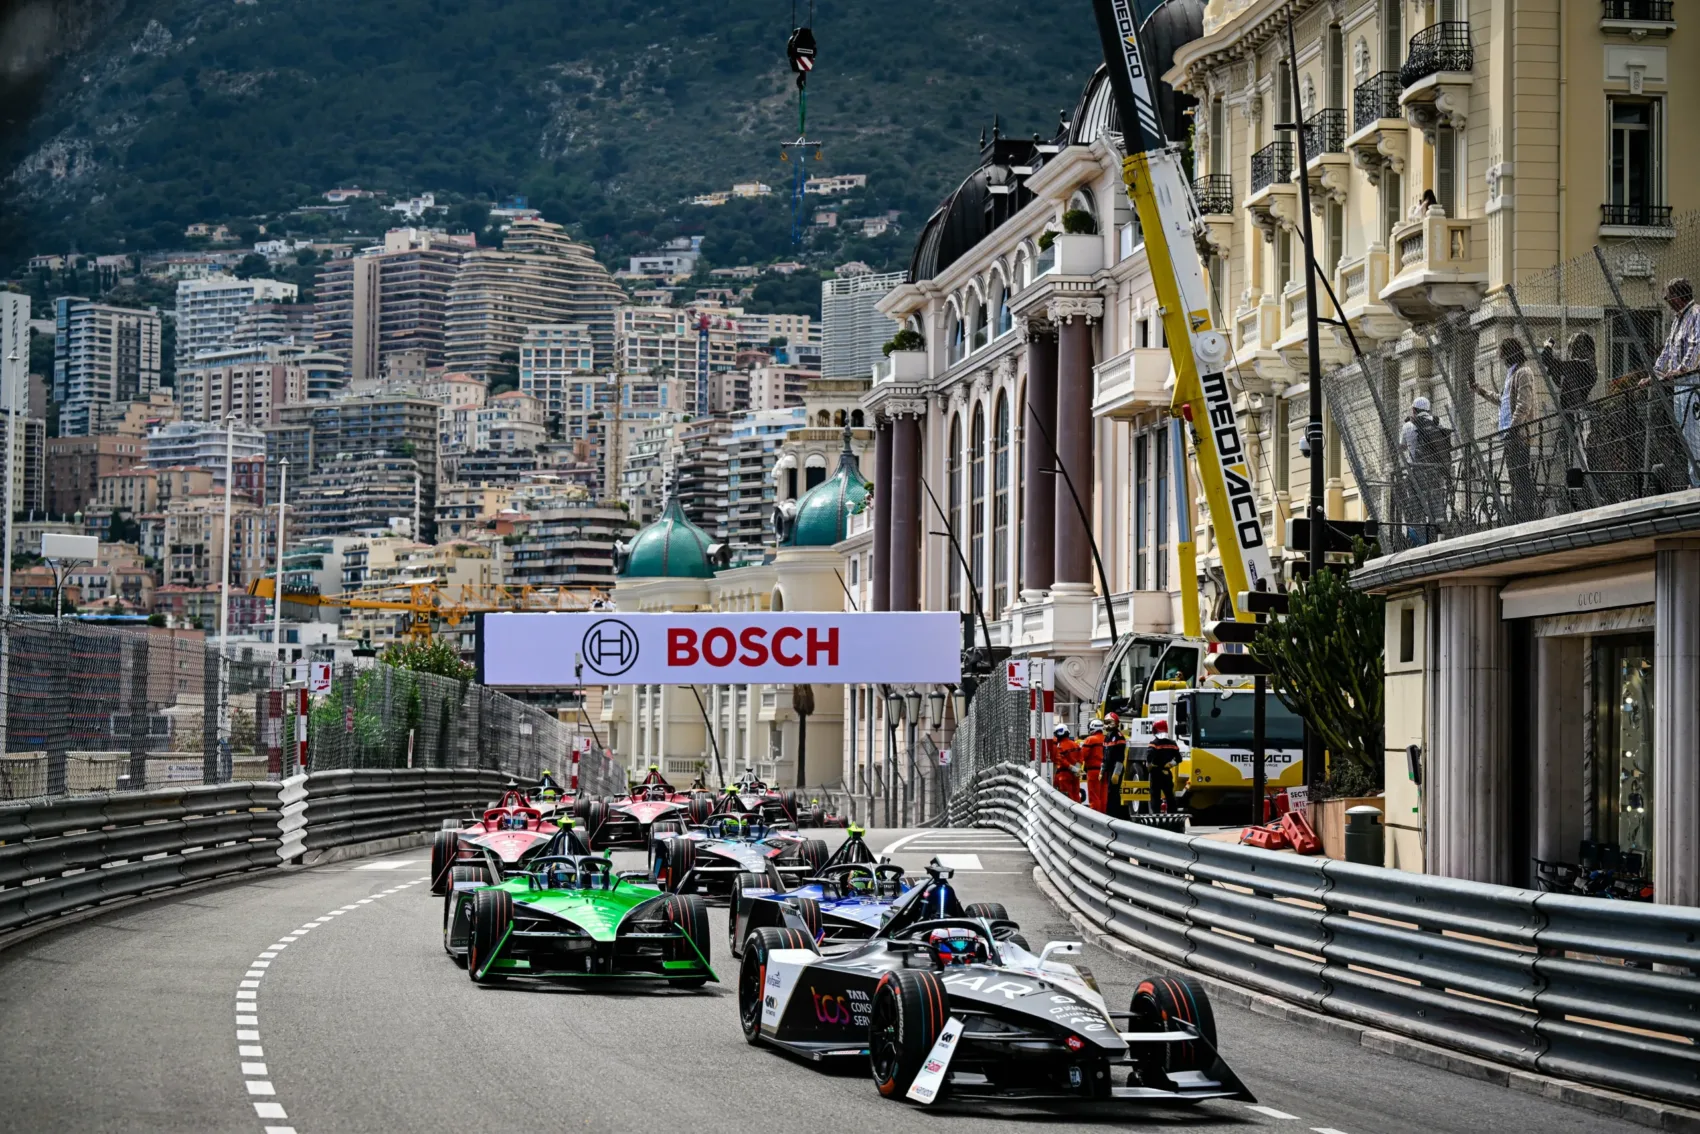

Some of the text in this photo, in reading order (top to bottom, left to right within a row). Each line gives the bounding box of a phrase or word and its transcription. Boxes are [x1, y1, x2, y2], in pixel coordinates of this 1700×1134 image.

[1578, 591, 1602, 606] GUCCI
[667, 626, 839, 667] BOSCH
[811, 986, 851, 1025] tcs
[846, 989, 870, 1001] TATA
